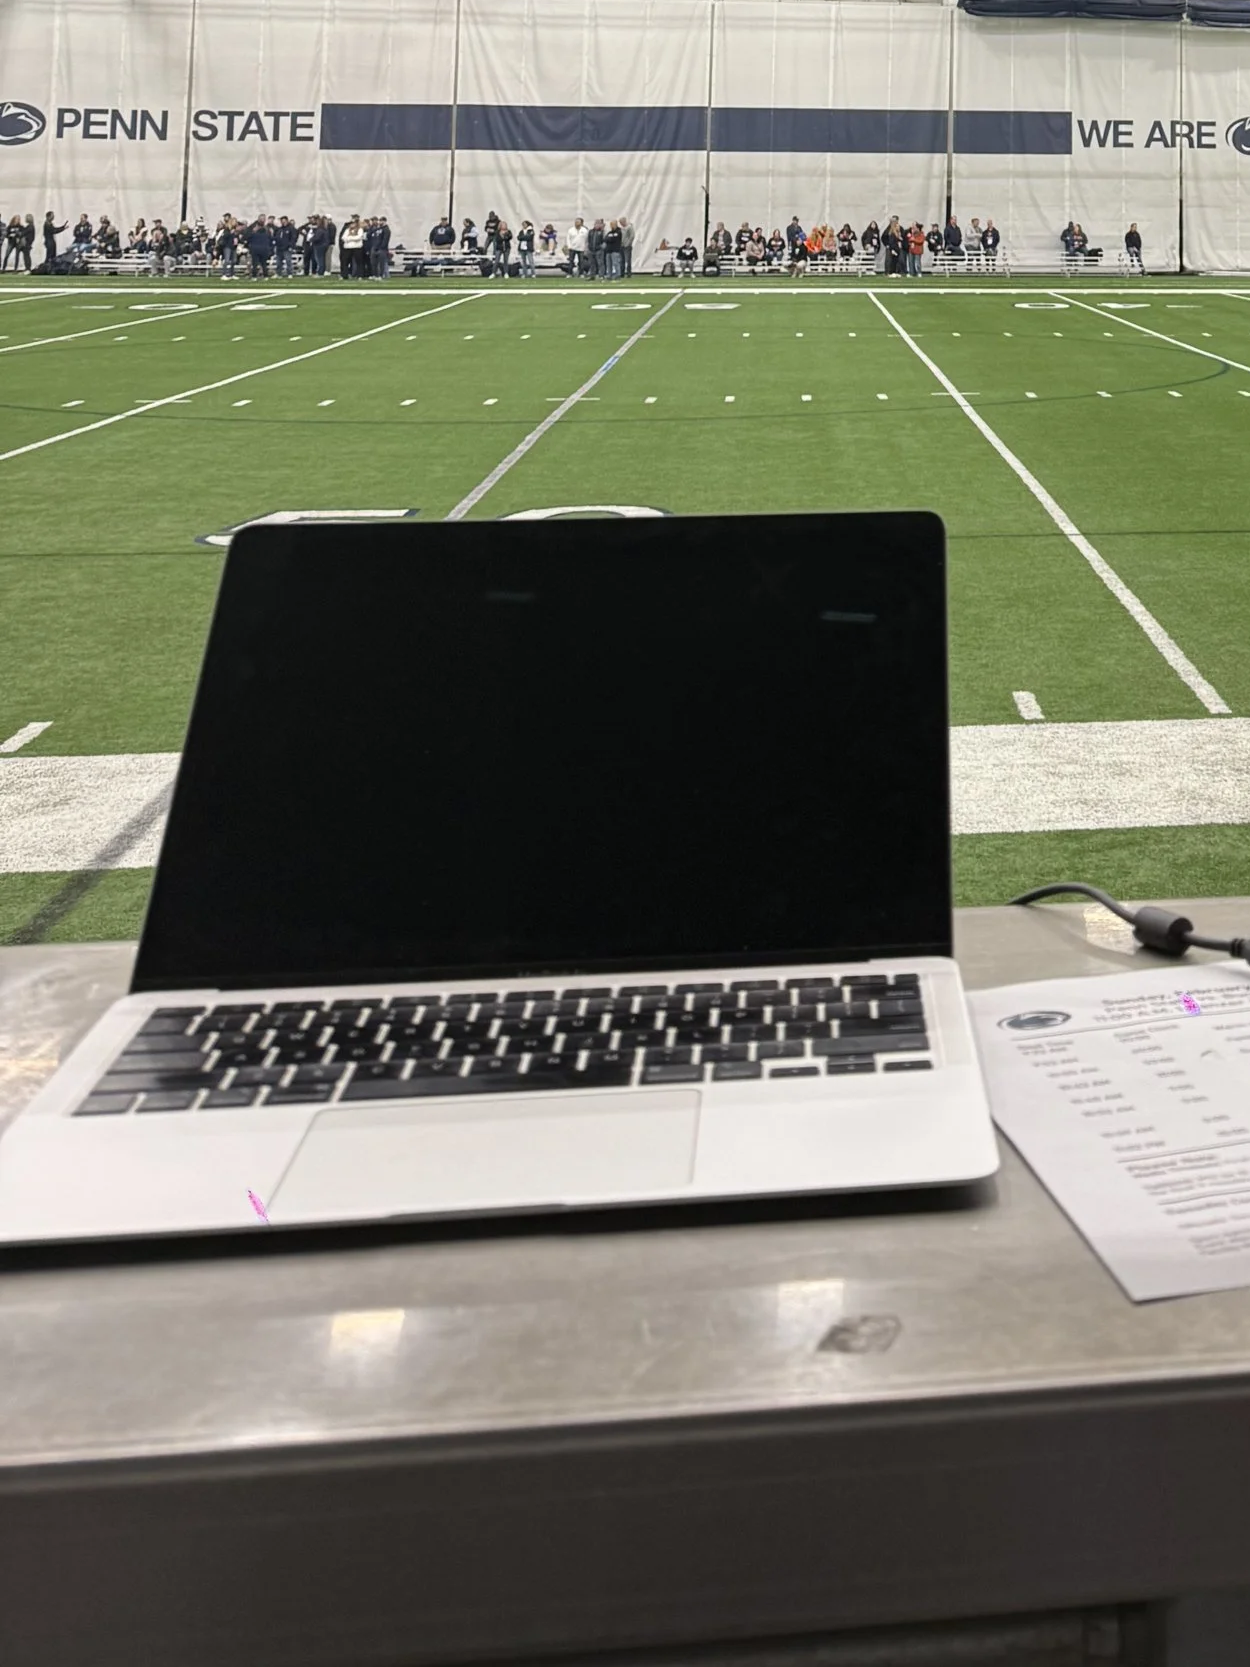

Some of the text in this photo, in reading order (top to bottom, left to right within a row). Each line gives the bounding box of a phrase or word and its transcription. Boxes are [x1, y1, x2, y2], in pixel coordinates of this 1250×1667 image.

[56, 107, 315, 142] PENN STATE
[1077, 119, 1134, 149] WE
[1144, 119, 1217, 149] ARE
